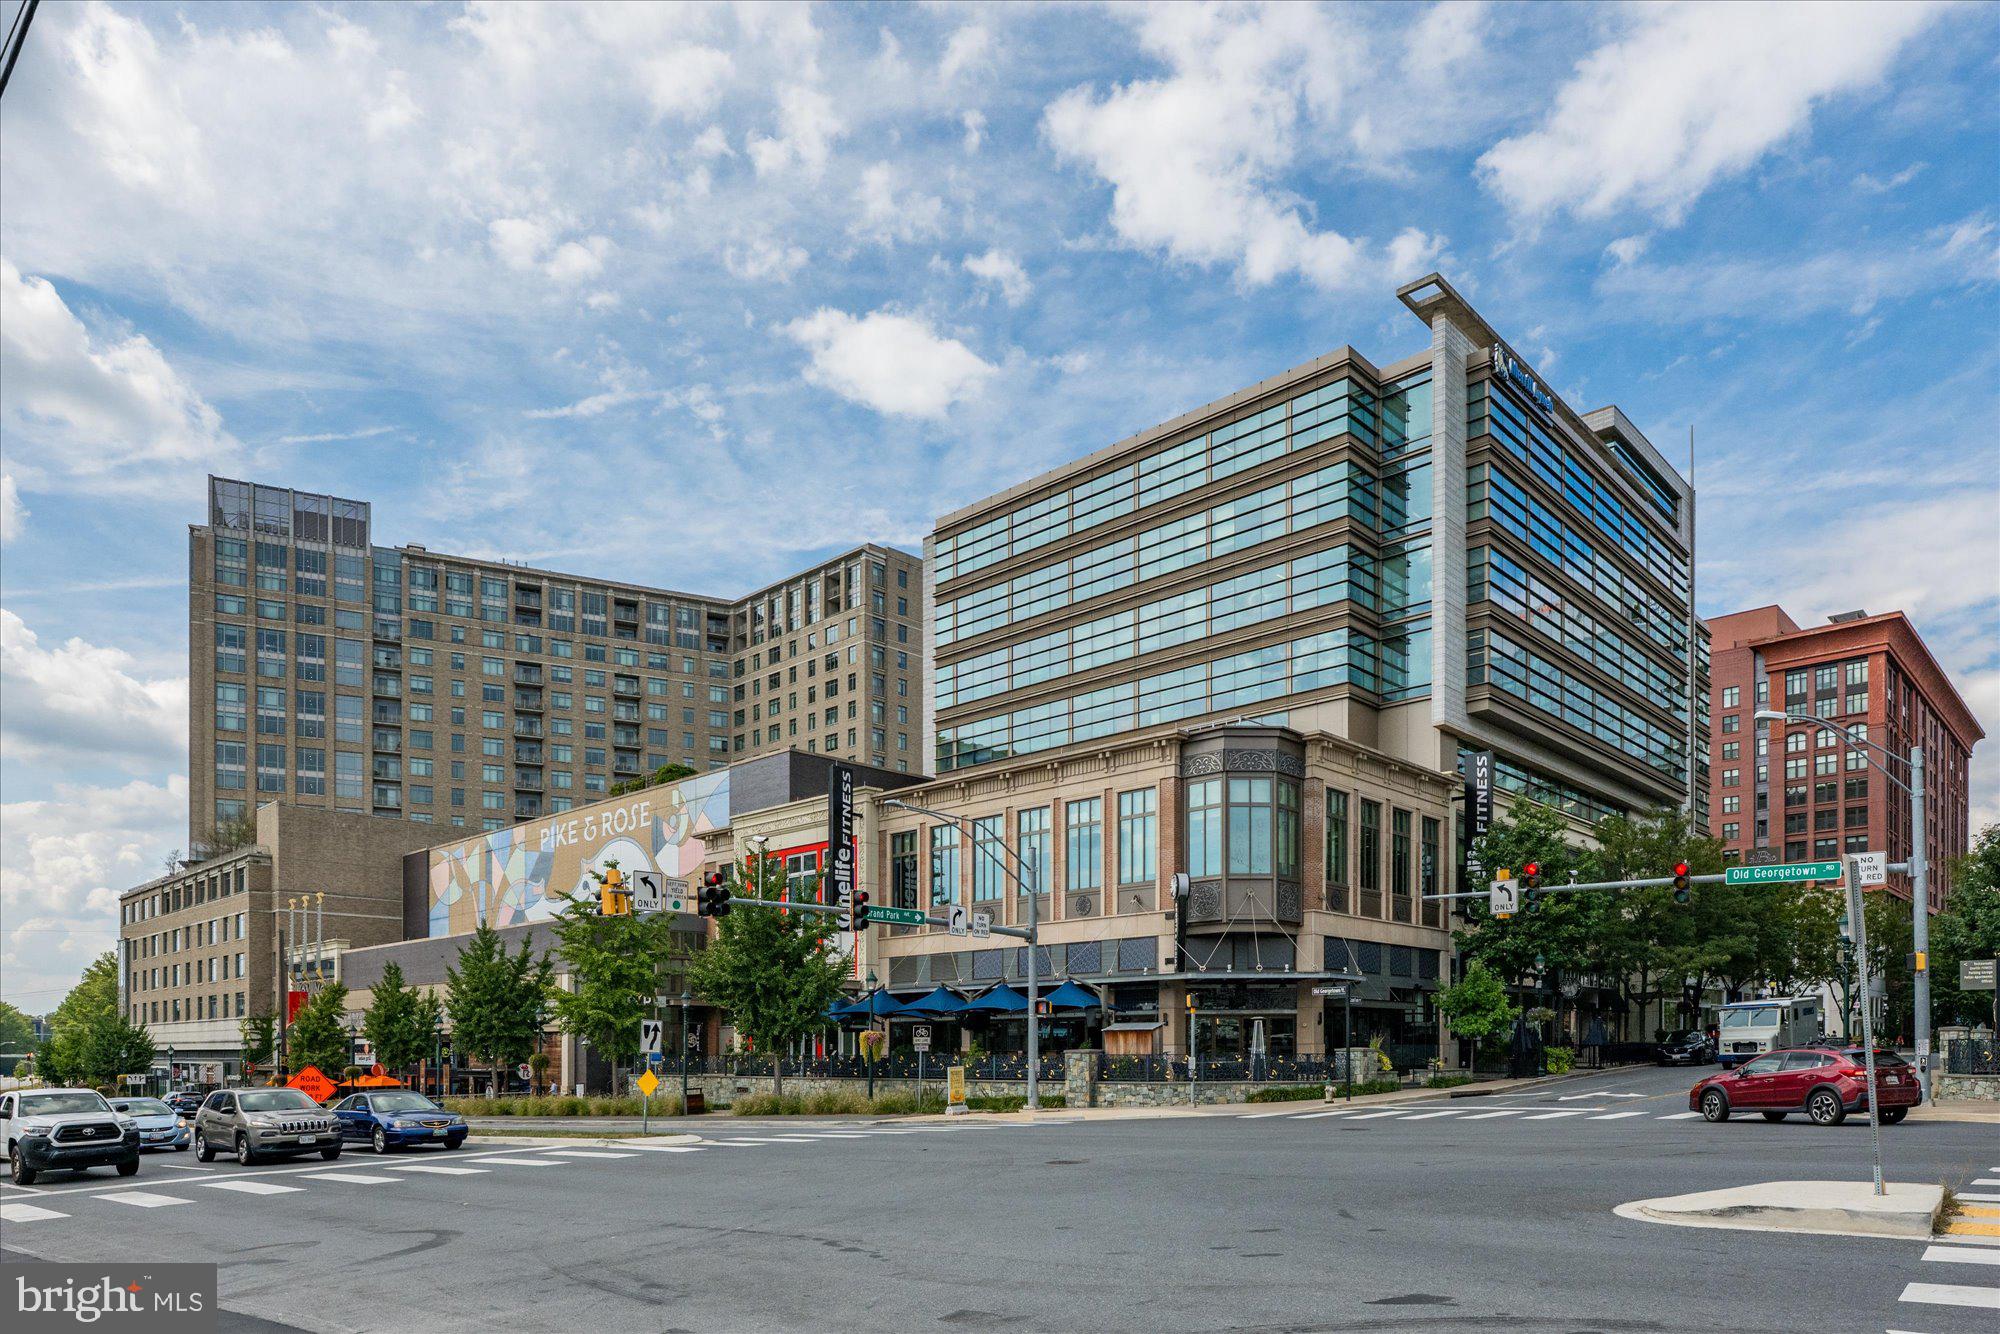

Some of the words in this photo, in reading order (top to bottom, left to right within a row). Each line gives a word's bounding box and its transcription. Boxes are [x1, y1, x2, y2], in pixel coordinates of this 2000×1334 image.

[1476, 755, 1488, 833] FITNESS
[841, 770, 852, 846] FITNESS
[540, 819, 579, 852] PIKE
[583, 815, 597, 842] &
[601, 800, 652, 837] ROSE
[1860, 856, 1874, 864] NO
[1732, 868, 1750, 880] Old
[1754, 865, 1817, 880] Georgetown
[1866, 872, 1883, 881] RED
[637, 899, 659, 908] ONLY
[1494, 902, 1515, 911] ONLY
[886, 910, 900, 920] Park
[951, 926, 965, 935] ONLY
